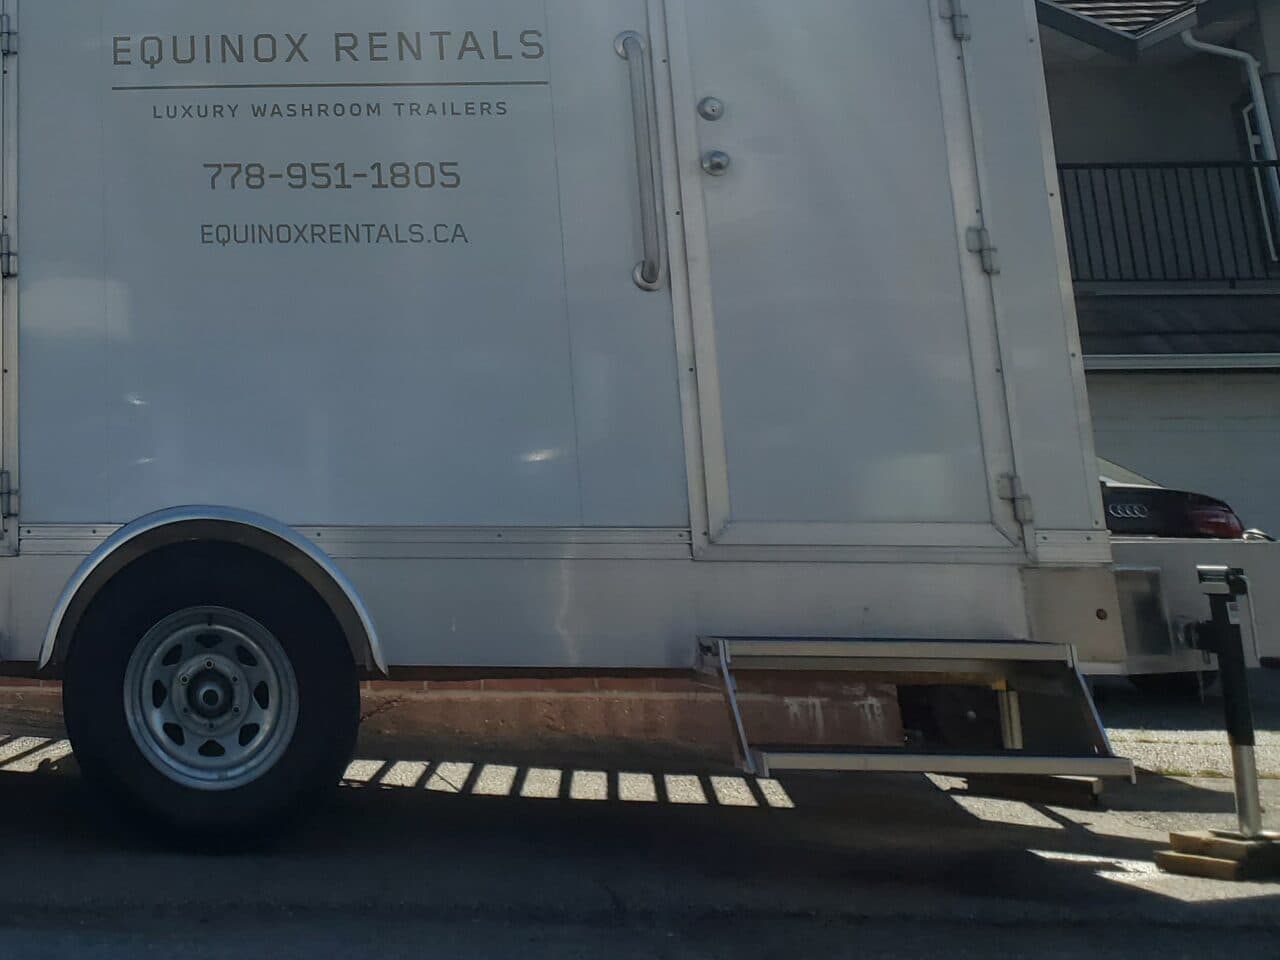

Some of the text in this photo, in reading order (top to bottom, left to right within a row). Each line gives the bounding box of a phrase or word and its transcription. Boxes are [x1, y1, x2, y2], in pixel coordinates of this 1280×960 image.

[112, 30, 545, 69] EQUINOX RENTALS
[152, 101, 508, 119] LUXURY WASHROOM TRAILERS
[203, 162, 461, 190] 778-951-1805
[200, 223, 469, 246] EQUINOXRENTALS.CA
